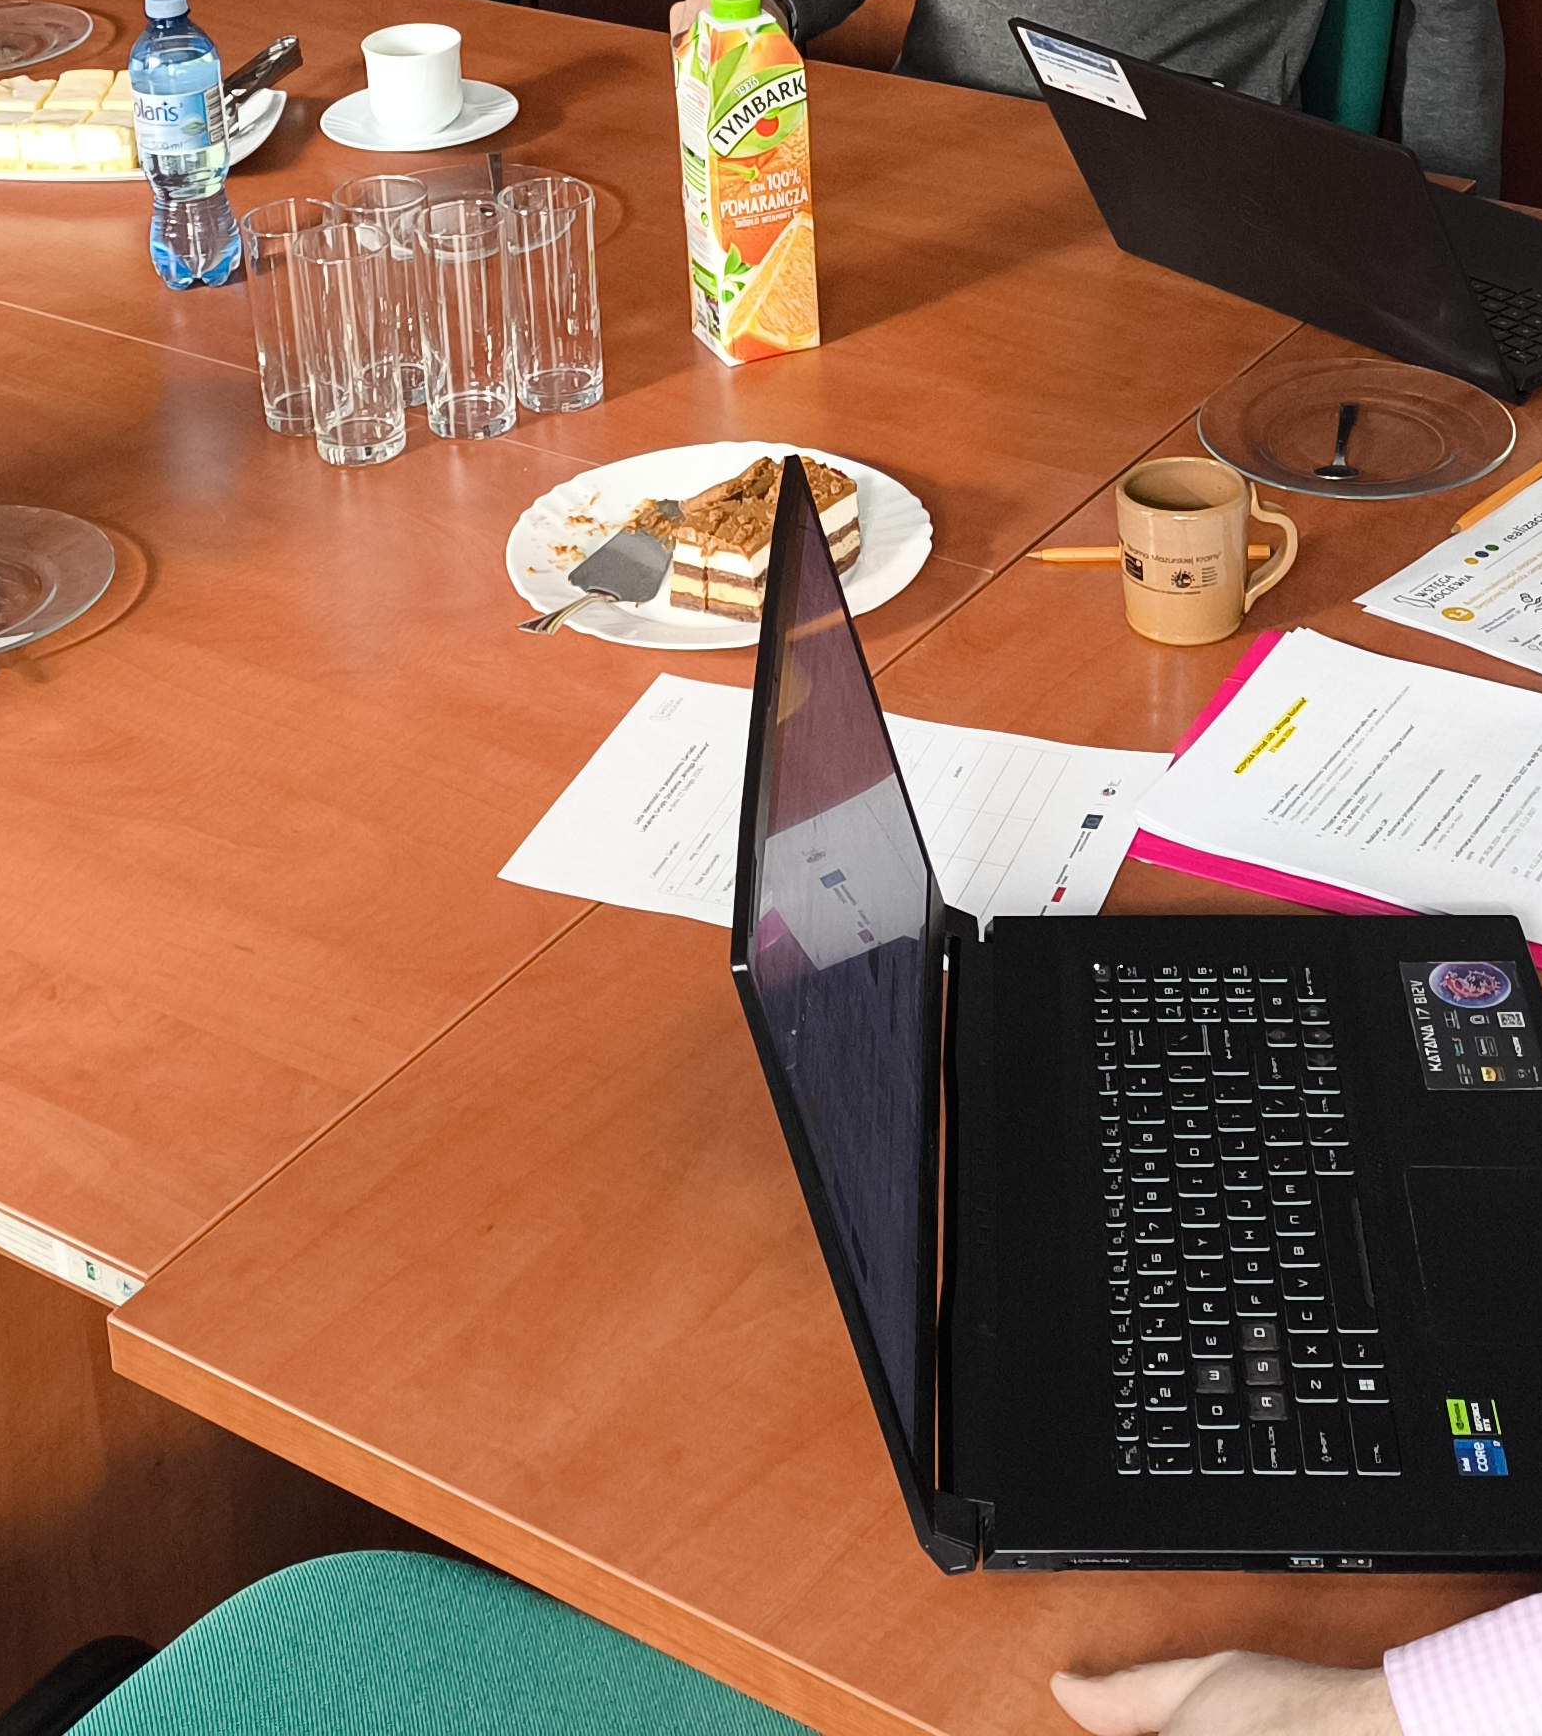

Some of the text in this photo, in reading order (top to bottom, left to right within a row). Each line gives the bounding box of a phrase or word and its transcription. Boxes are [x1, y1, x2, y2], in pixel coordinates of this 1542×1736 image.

[713, 75, 807, 146] TYMBARK
[766, 169, 802, 191] 100%
[720, 185, 809, 219] POMARAŃCZA
[1429, 574, 1475, 609] KOCIEWIA
[1421, 1025, 1443, 1072] KATANA
[1474, 1442, 1489, 1472] CORE
